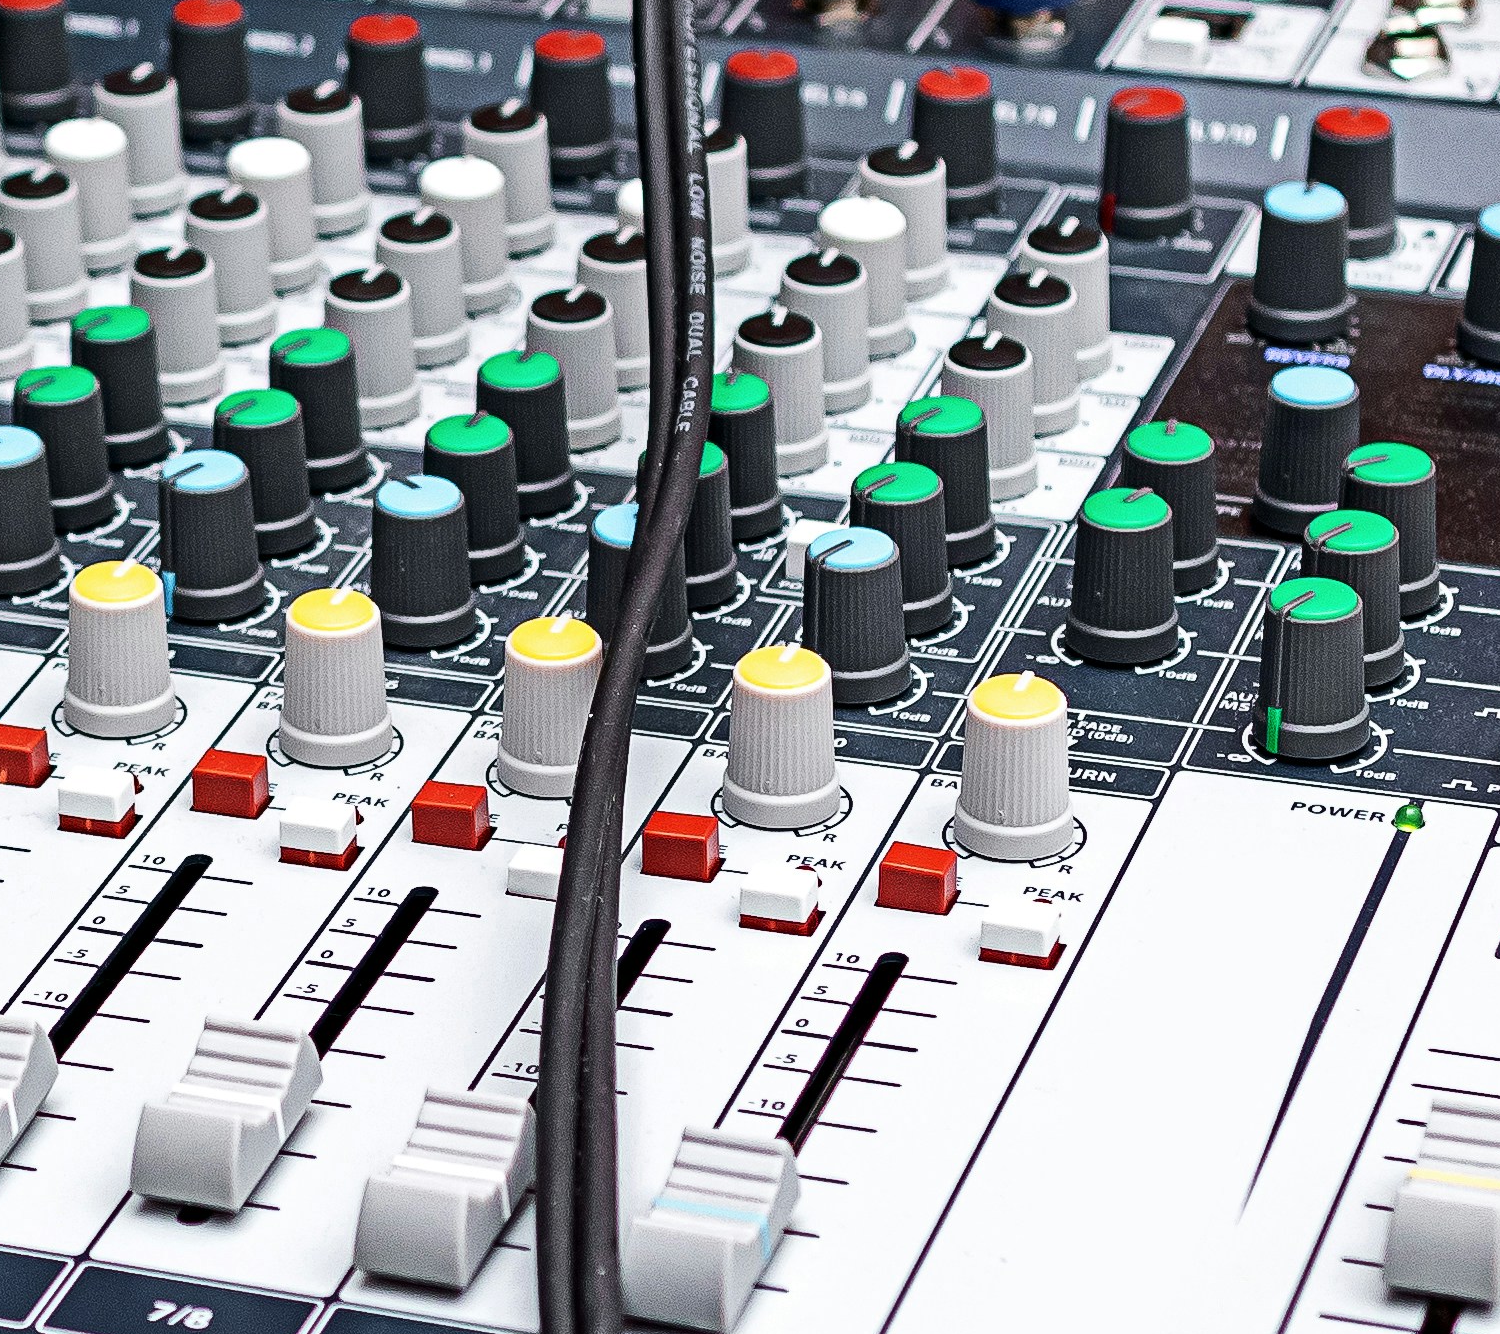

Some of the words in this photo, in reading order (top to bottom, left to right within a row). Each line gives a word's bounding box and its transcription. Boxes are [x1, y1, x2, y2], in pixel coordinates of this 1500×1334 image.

[689, 236, 707, 296] NOISE
[687, 311, 705, 362] DUAL
[674, 375, 699, 435] CABLE
[1158, 670, 1198, 682] 10dB
[669, 681, 708, 695] 10dB
[1389, 698, 1430, 710] 10dB
[892, 711, 933, 724] 10dB
[1077, 720, 1123, 735] FADE
[112, 761, 172, 778] PEAK
[1069, 766, 1118, 784] URN
[1355, 769, 1398, 782] 10dB
[332, 791, 391, 809] PEAK
[1290, 800, 1386, 823] POWER
[142, 854, 166, 866] 10
[786, 854, 846, 871] PEAK
[366, 887, 391, 899] 10
[1022, 885, 1085, 903] PEAK
[834, 952, 861, 965] 10
[32, 990, 69, 1003] -10
[502, 1062, 539, 1075] -10
[747, 1098, 786, 1111] -10
[146, 1300, 213, 1332] 7/8
